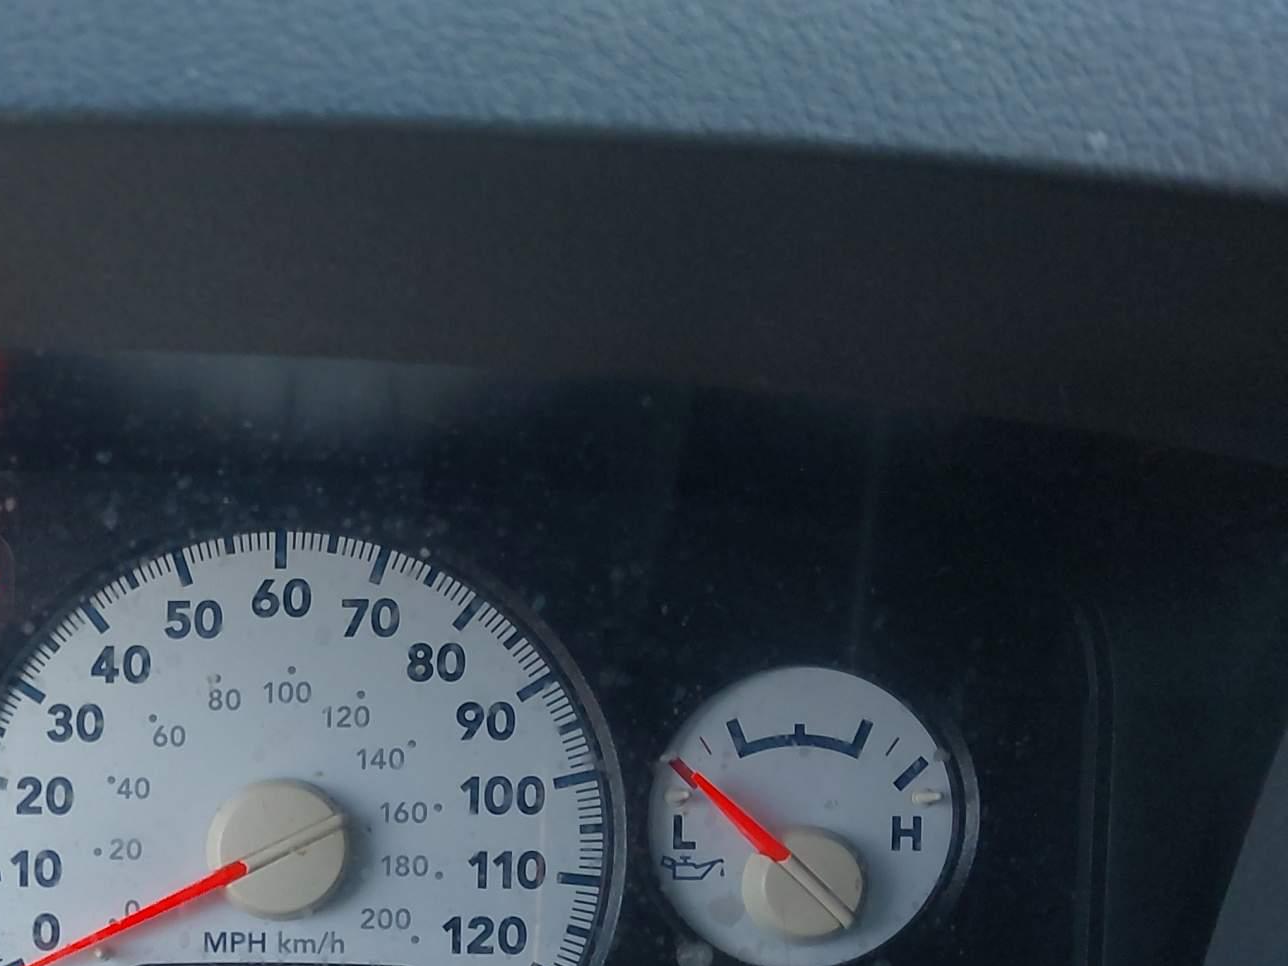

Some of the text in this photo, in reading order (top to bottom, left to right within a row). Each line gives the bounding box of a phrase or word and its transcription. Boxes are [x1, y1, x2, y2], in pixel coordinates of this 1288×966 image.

[252, 579, 312, 618] 60
[164, 600, 223, 639] 50
[342, 598, 400, 638] 70
[90, 645, 151, 684] 40
[407, 643, 466, 682] 80
[208, 689, 241, 712] 80
[263, 681, 312, 704] 100
[47, 705, 104, 743] 30
[322, 706, 371, 728] 120
[456, 702, 515, 741] 90
[153, 725, 187, 748] 60
[357, 748, 405, 770] 140
[16, 778, 74, 815] 20
[117, 778, 151, 799] 40
[460, 776, 545, 815] 100
[380, 802, 428, 824] 160
[109, 839, 142, 861] 20
[673, 815, 696, 850] L
[891, 816, 922, 851] H
[11, 851, 62, 888] 10
[381, 856, 429, 878] 180
[468, 851, 546, 890] 110
[33, 914, 60, 951] 0
[360, 908, 412, 930] 200
[442, 917, 527, 955] 120
[203, 931, 345, 954] MPH km/h
